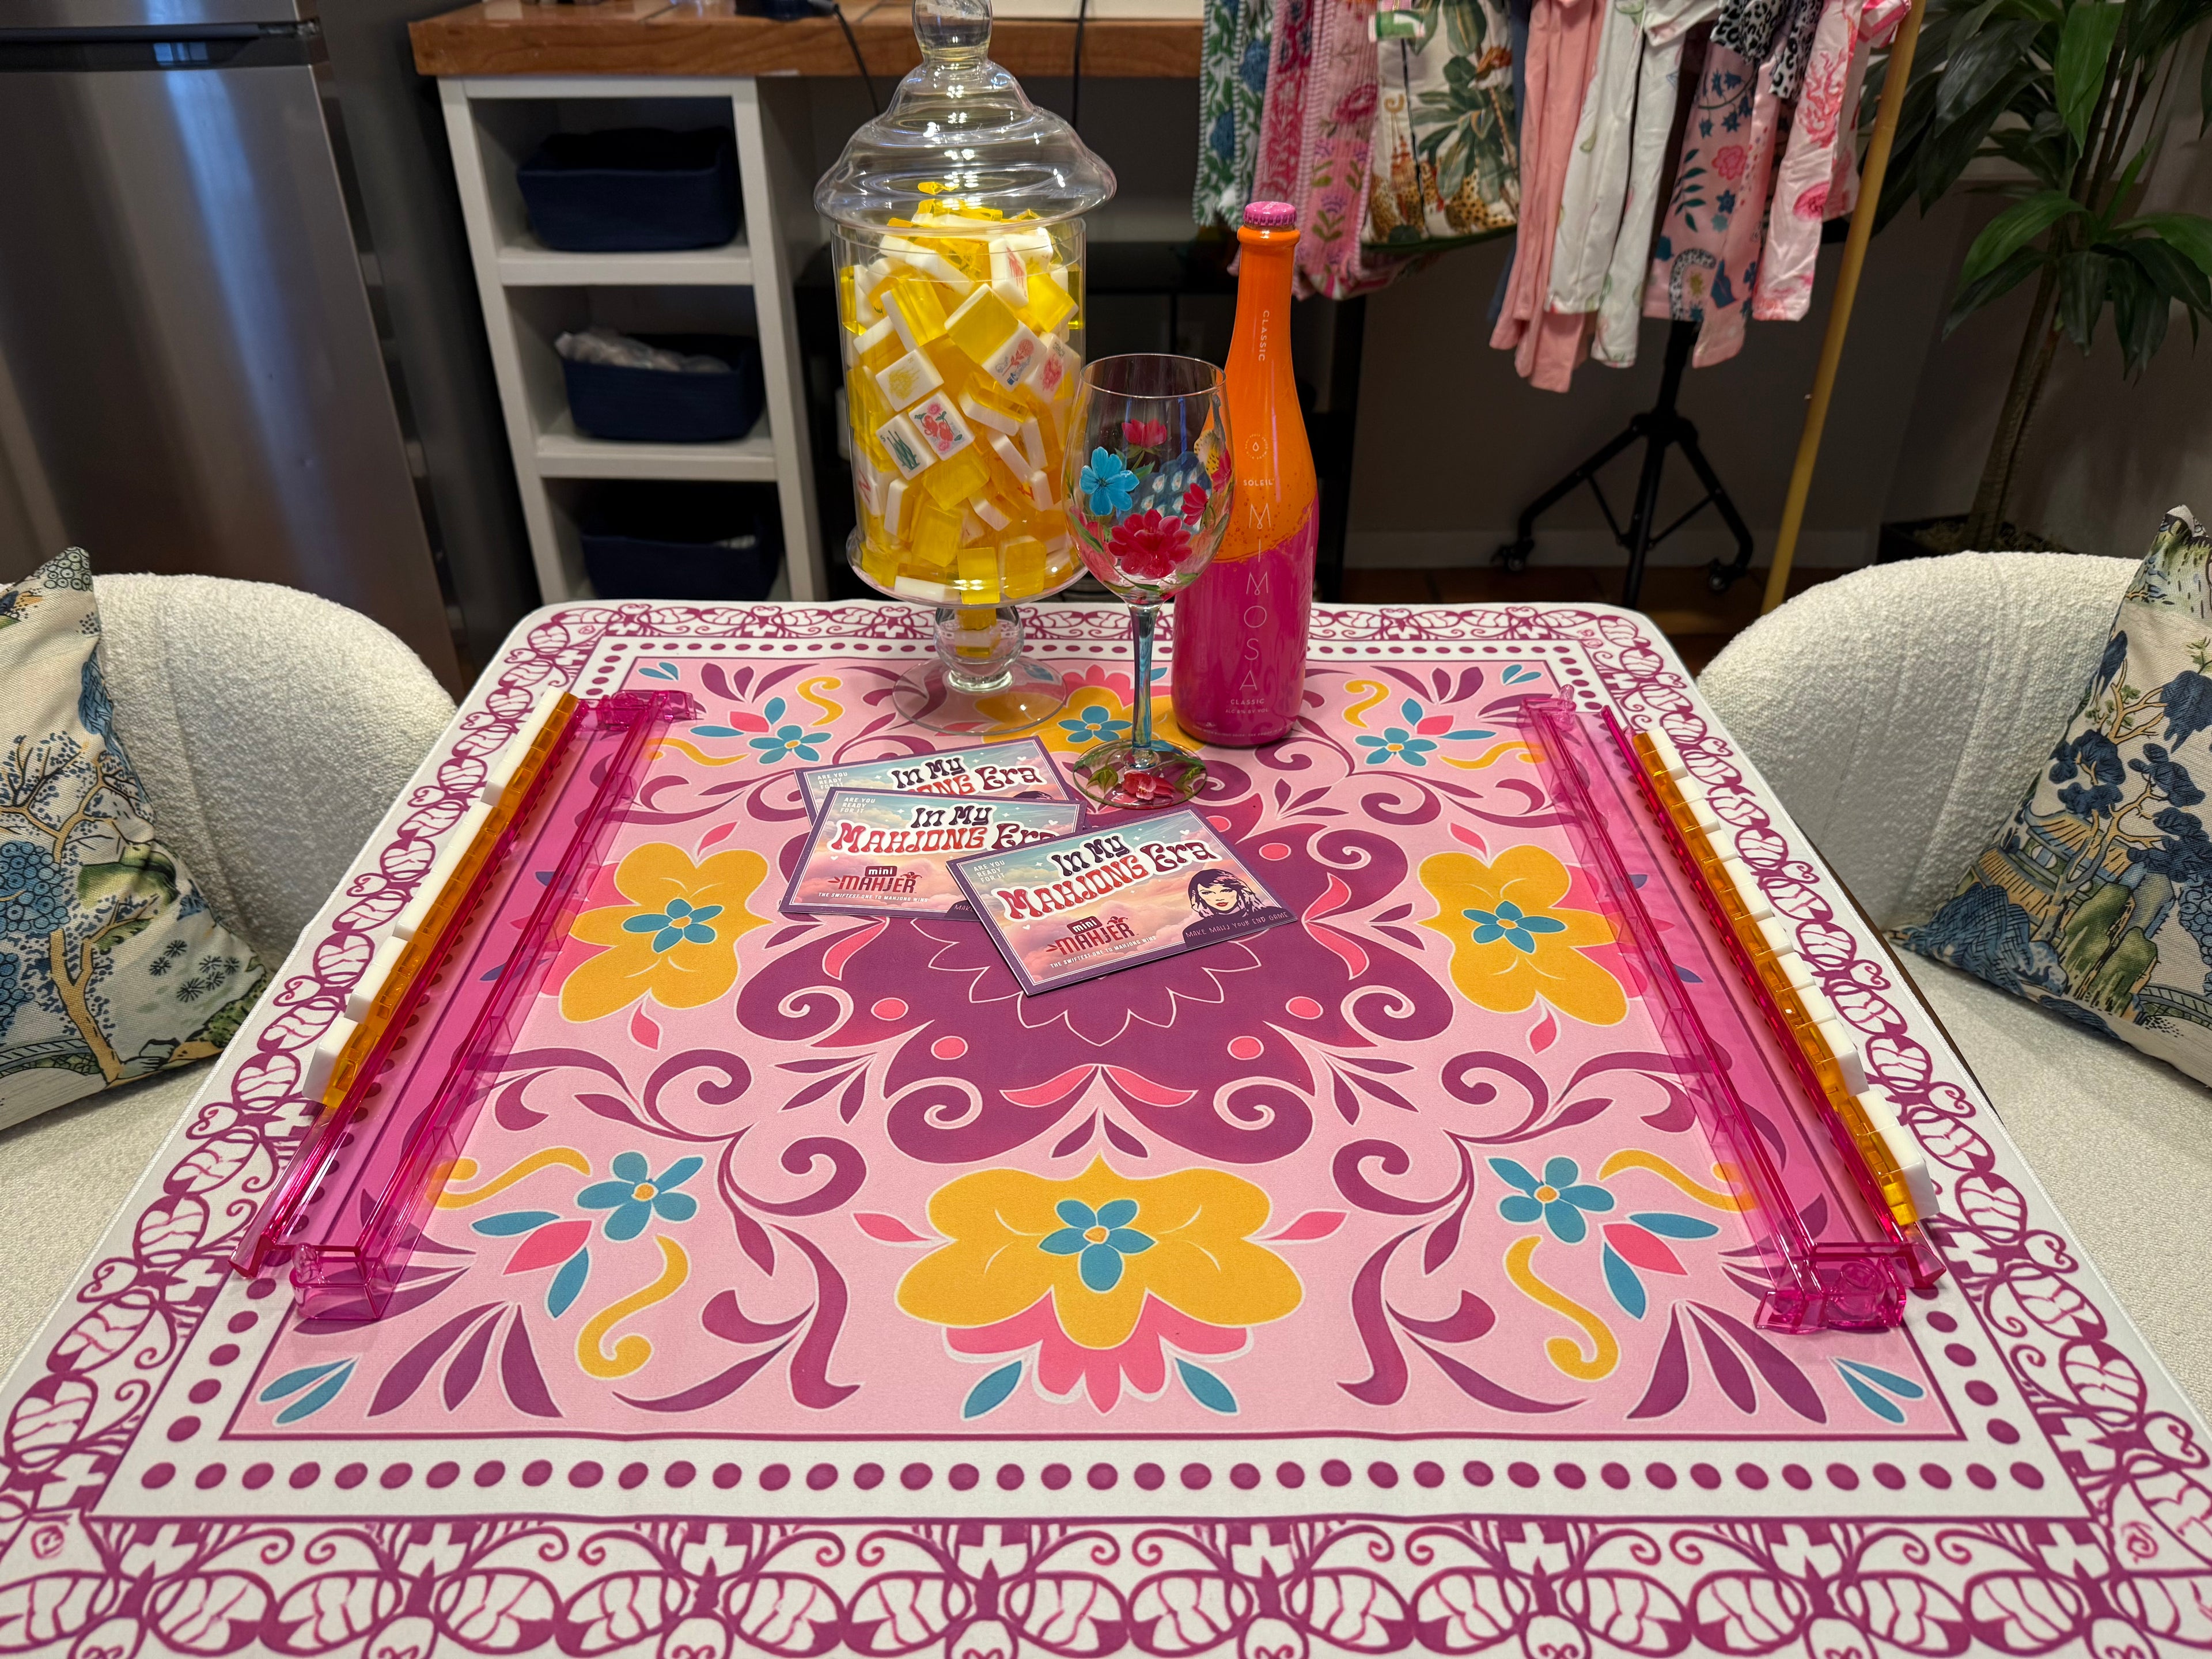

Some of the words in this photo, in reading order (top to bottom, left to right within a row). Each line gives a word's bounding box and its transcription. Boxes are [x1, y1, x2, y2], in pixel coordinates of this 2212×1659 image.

[1258, 310, 1270, 361] CLASSIC
[1239, 503, 1271, 691] MIMOSA
[892, 768, 924, 789] In
[925, 757, 965, 779] My
[975, 766, 1043, 790] Era
[911, 808, 946, 828] In
[949, 805, 992, 826] My
[831, 822, 988, 853] MAHJONG
[974, 863, 988, 872] ARE
[1051, 851, 1090, 876] In
[1084, 836, 1130, 863] My
[838, 875, 918, 893] MAHJER
[868, 867, 893, 876] mini
[977, 867, 1001, 877] READY
[980, 875, 995, 883] FOR
[997, 855, 1149, 919] MAHJONG
[1140, 842, 1218, 872] Era
[1072, 918, 1097, 933] mini
[1185, 929, 1207, 938] MAKE
[1252, 916, 1266, 924] END
[1268, 912, 1289, 921] GAME
[1054, 923, 1135, 955] MAHJER
[1063, 953, 1091, 965] SWIFTEST
[1114, 940, 1141, 951] MAHJONG
